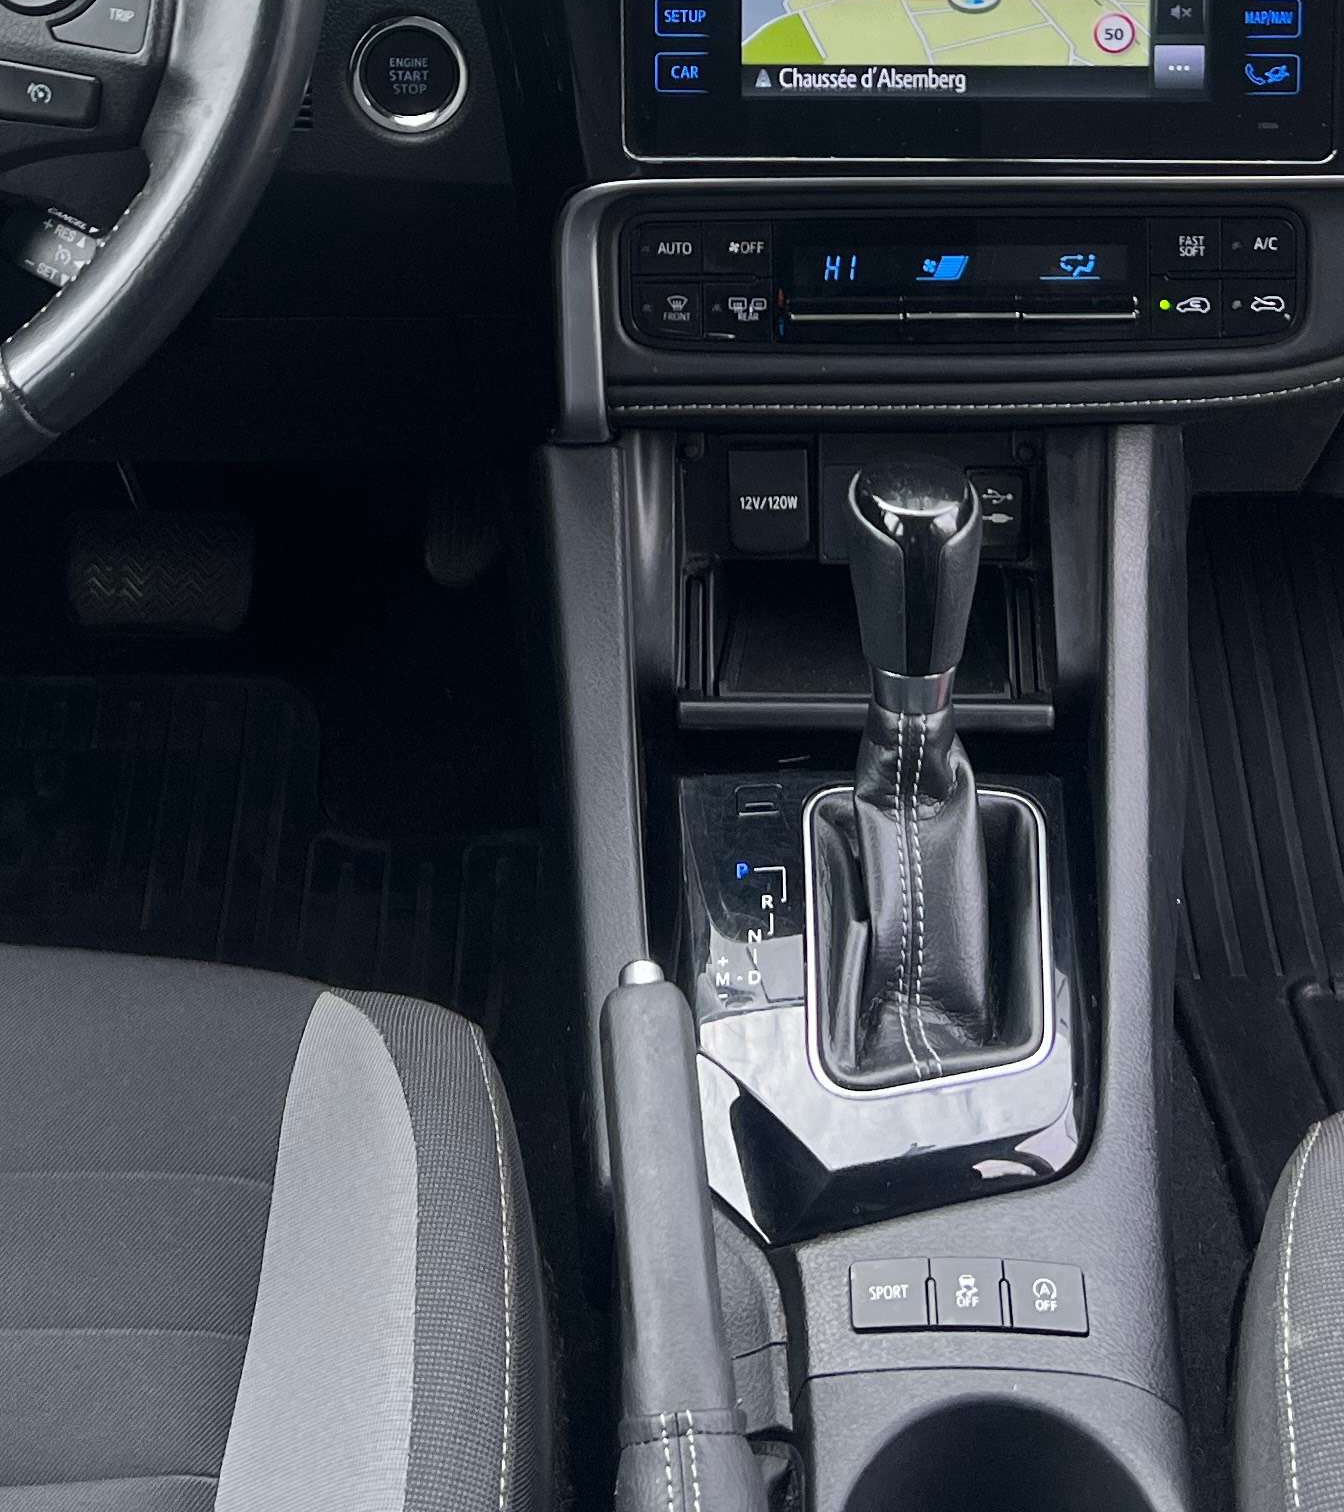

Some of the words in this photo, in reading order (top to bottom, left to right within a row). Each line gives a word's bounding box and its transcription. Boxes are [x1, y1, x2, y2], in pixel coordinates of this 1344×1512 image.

[109, 7, 136, 22] TRIP
[663, 9, 706, 23] SETUP
[1244, 10, 1293, 25] MAP/NAV
[1104, 28, 1124, 41] 50
[389, 57, 429, 68] ENGINE
[388, 70, 429, 81] START
[670, 65, 699, 79] CAR
[779, 68, 857, 89] Chaussée
[861, 67, 966, 92] d'Alsemberg
[393, 83, 428, 95] STOP
[54, 224, 77, 243] RES
[1178, 235, 1205, 246] FAST
[657, 242, 693, 255] AUTO
[740, 241, 765, 255] OFF
[1254, 236, 1278, 250] A/C
[1179, 246, 1206, 257] SOFT
[36, 262, 58, 280] SET
[663, 311, 691, 321] FRONT
[737, 310, 759, 321] REAR
[739, 496, 798, 511] 12V/120W
[736, 863, 749, 879] P
[761, 894, 774, 909] R
[747, 929, 762, 945] N
[715, 971, 730, 986] M
[747, 970, 762, 984] D
[868, 1284, 909, 1301] SPORT
[1039, 1282, 1051, 1295] A
[956, 1295, 980, 1308] OFF
[1035, 1299, 1058, 1312] OFF
